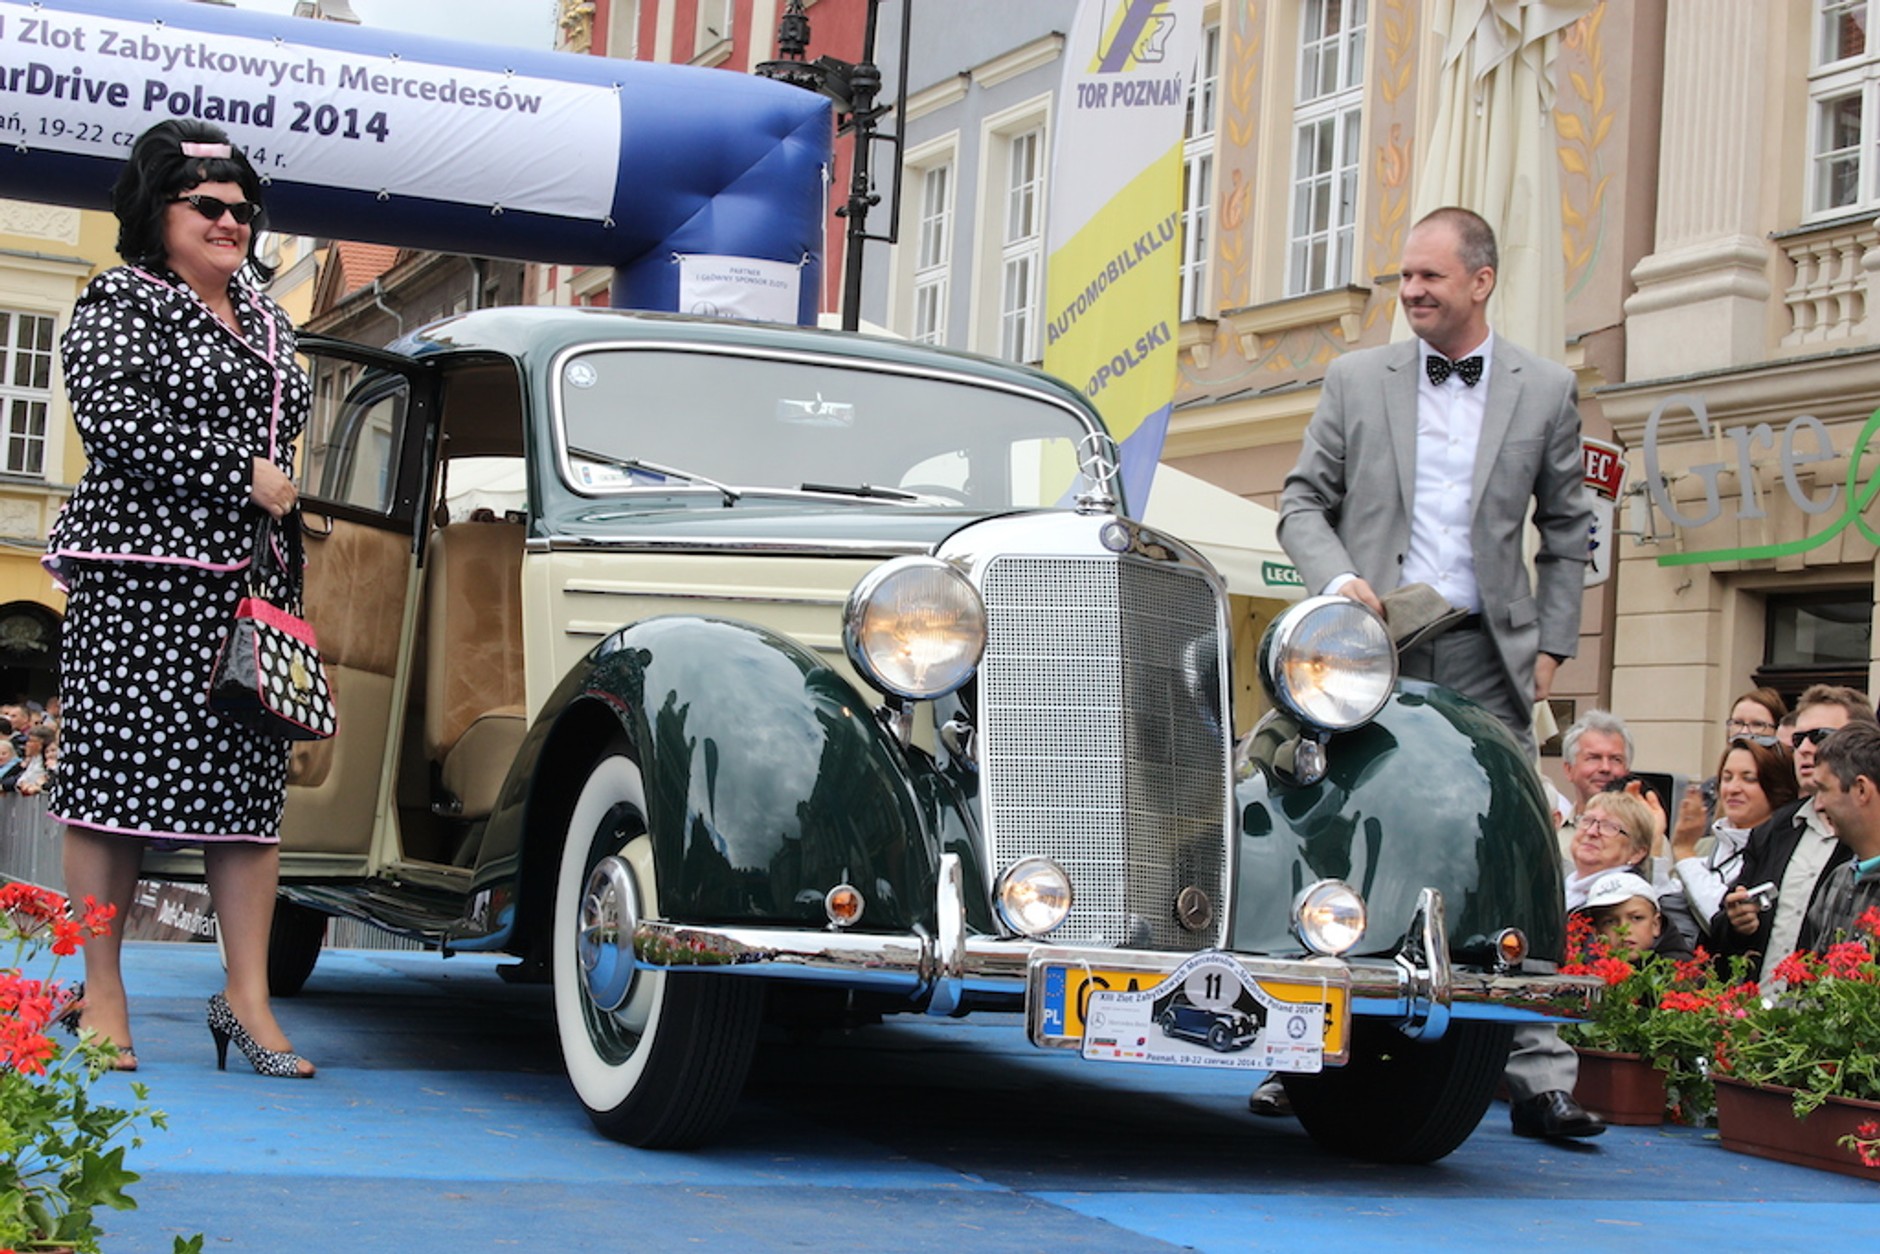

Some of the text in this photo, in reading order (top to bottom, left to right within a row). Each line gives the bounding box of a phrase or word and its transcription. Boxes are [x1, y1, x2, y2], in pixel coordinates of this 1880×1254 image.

[18, 17, 86, 52] Zlot
[98, 29, 326, 87] Zabytkowych
[338, 64, 543, 115] Mercedesów
[1077, 71, 1182, 109] TOR POZNAŃ
[143, 79, 276, 128] Poland
[290, 100, 389, 143] 2014
[38, 117, 104, 143] 19-22
[274, 151, 287, 168] r.
[729, 267, 761, 276] PARTNER
[735, 275, 767, 286] SPONSOR
[1584, 450, 1612, 483] EC
[1116, 993, 1134, 1003] Zlot
[1205, 972, 1222, 1000] 11
[1043, 1008, 1061, 1025] PL
[1180, 1055, 1202, 1064] 19-22
[1237, 1058, 1255, 1067] 2014
